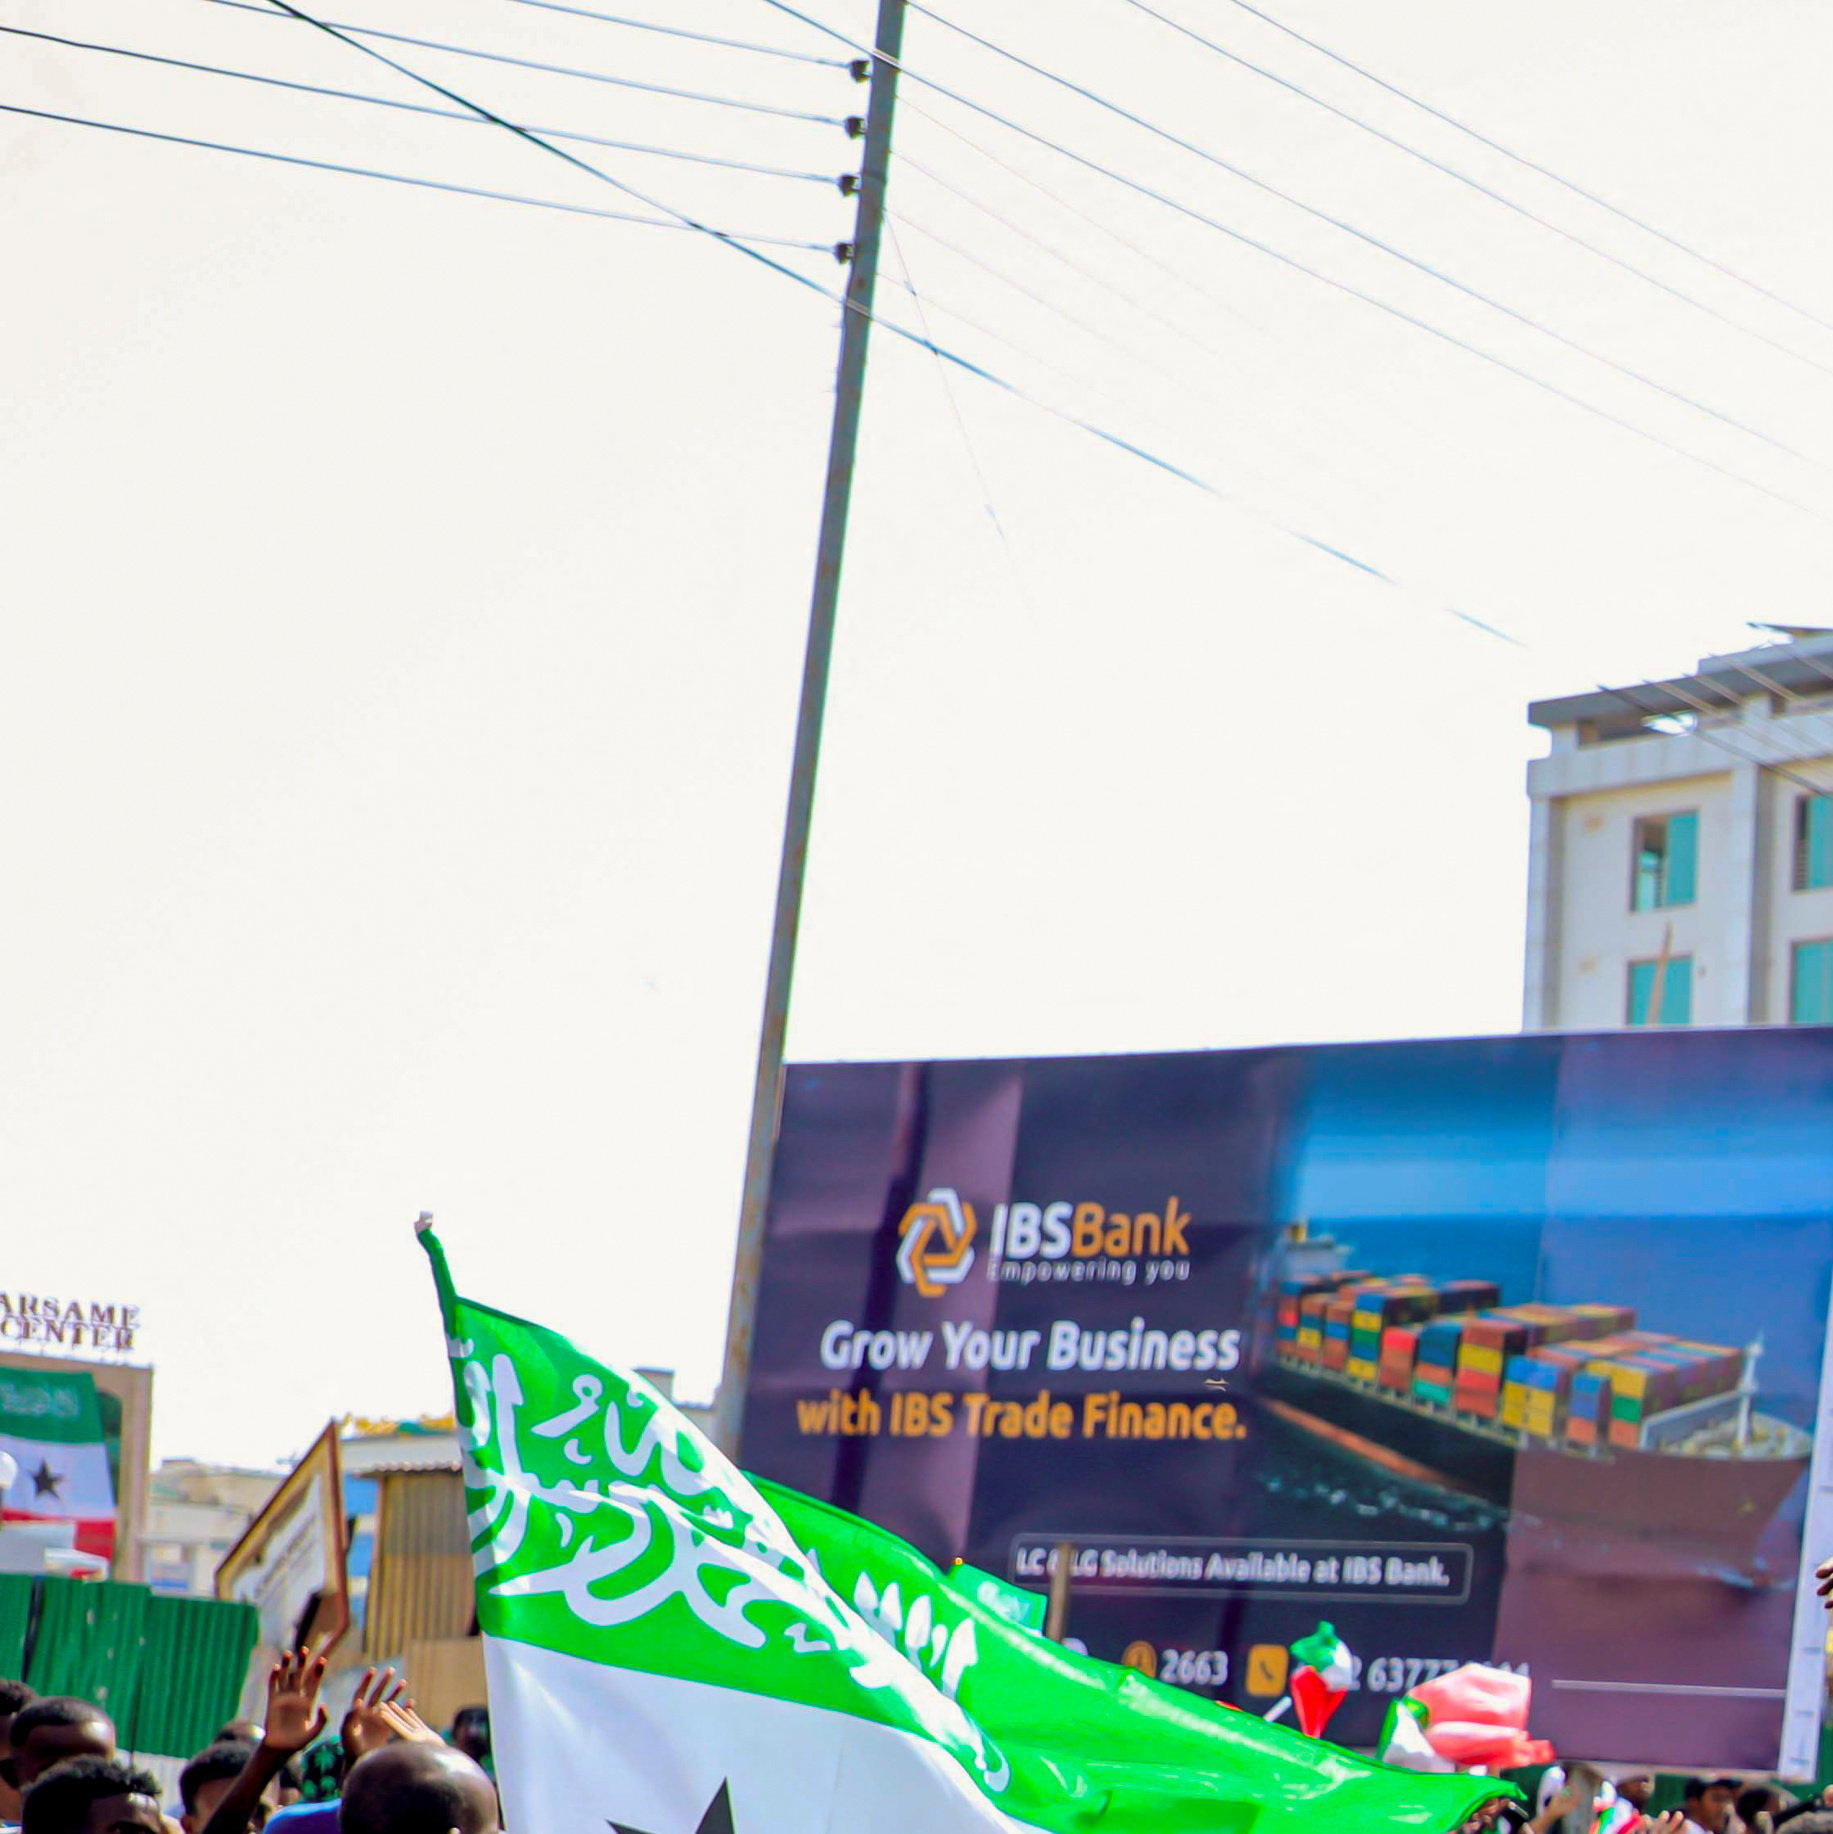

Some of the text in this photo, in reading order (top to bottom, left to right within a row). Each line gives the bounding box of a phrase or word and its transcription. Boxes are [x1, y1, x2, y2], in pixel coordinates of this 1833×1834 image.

[990, 1196, 1192, 1260] IBSBank
[988, 1257, 1191, 1287] Empowering you
[820, 1315, 1242, 1371] Grow Your Business
[797, 1388, 1248, 1440] with IBS Trade Finance.
[1016, 1546, 1046, 1576] LC
[1100, 1549, 1203, 1581] Solutions
[1204, 1551, 1310, 1583] Available
[1312, 1556, 1339, 1583] at
[1342, 1556, 1382, 1586] IBS
[1384, 1556, 1450, 1588] Bank.
[1159, 1648, 1228, 1686] 2663
